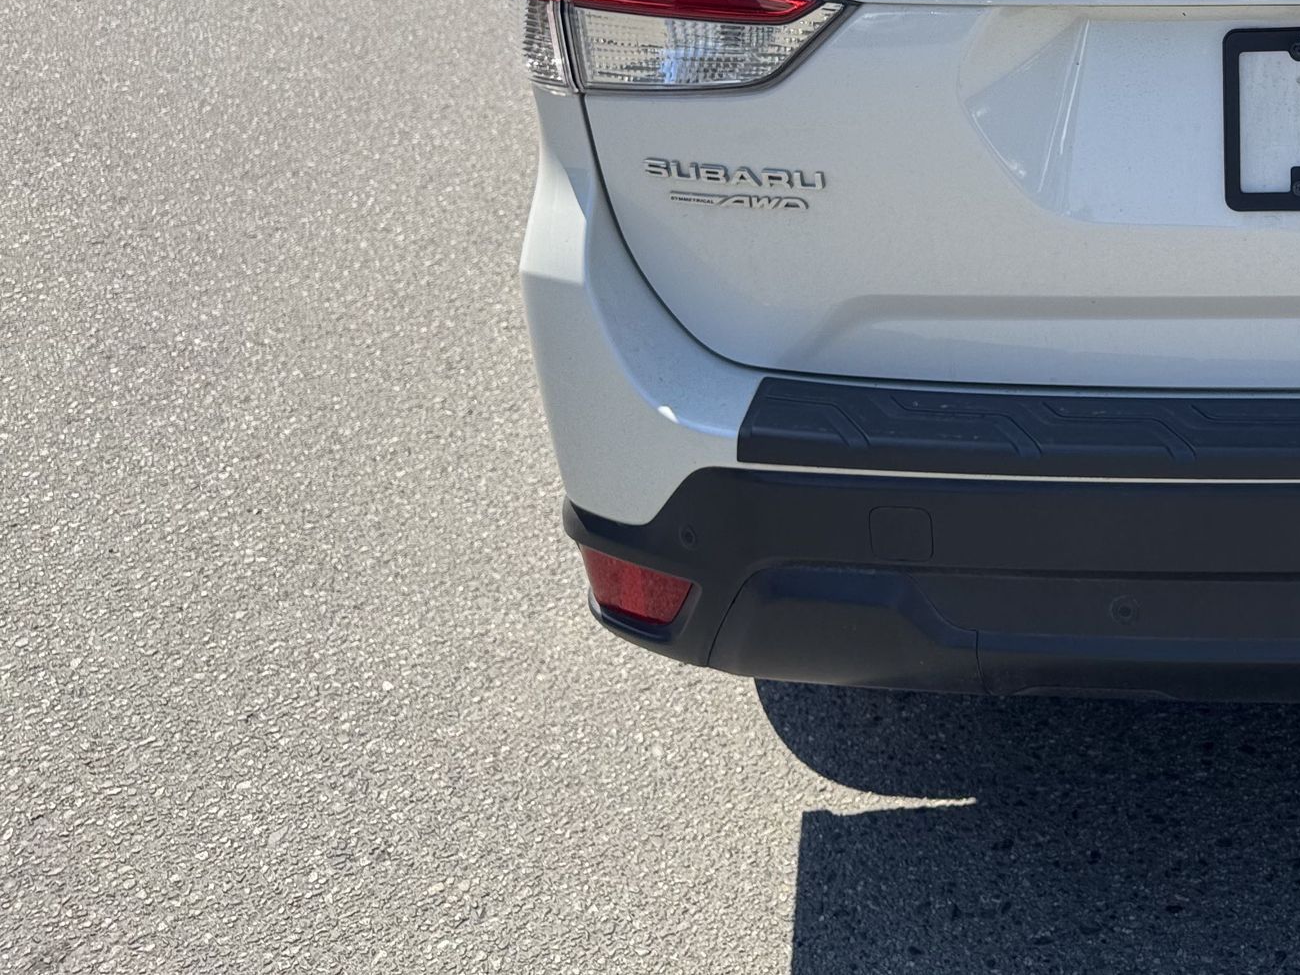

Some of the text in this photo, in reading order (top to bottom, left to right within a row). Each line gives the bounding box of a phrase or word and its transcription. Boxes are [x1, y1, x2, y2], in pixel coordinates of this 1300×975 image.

[645, 157, 826, 190] SUBARU
[670, 194, 809, 209] SYMMETRICAL AWD
